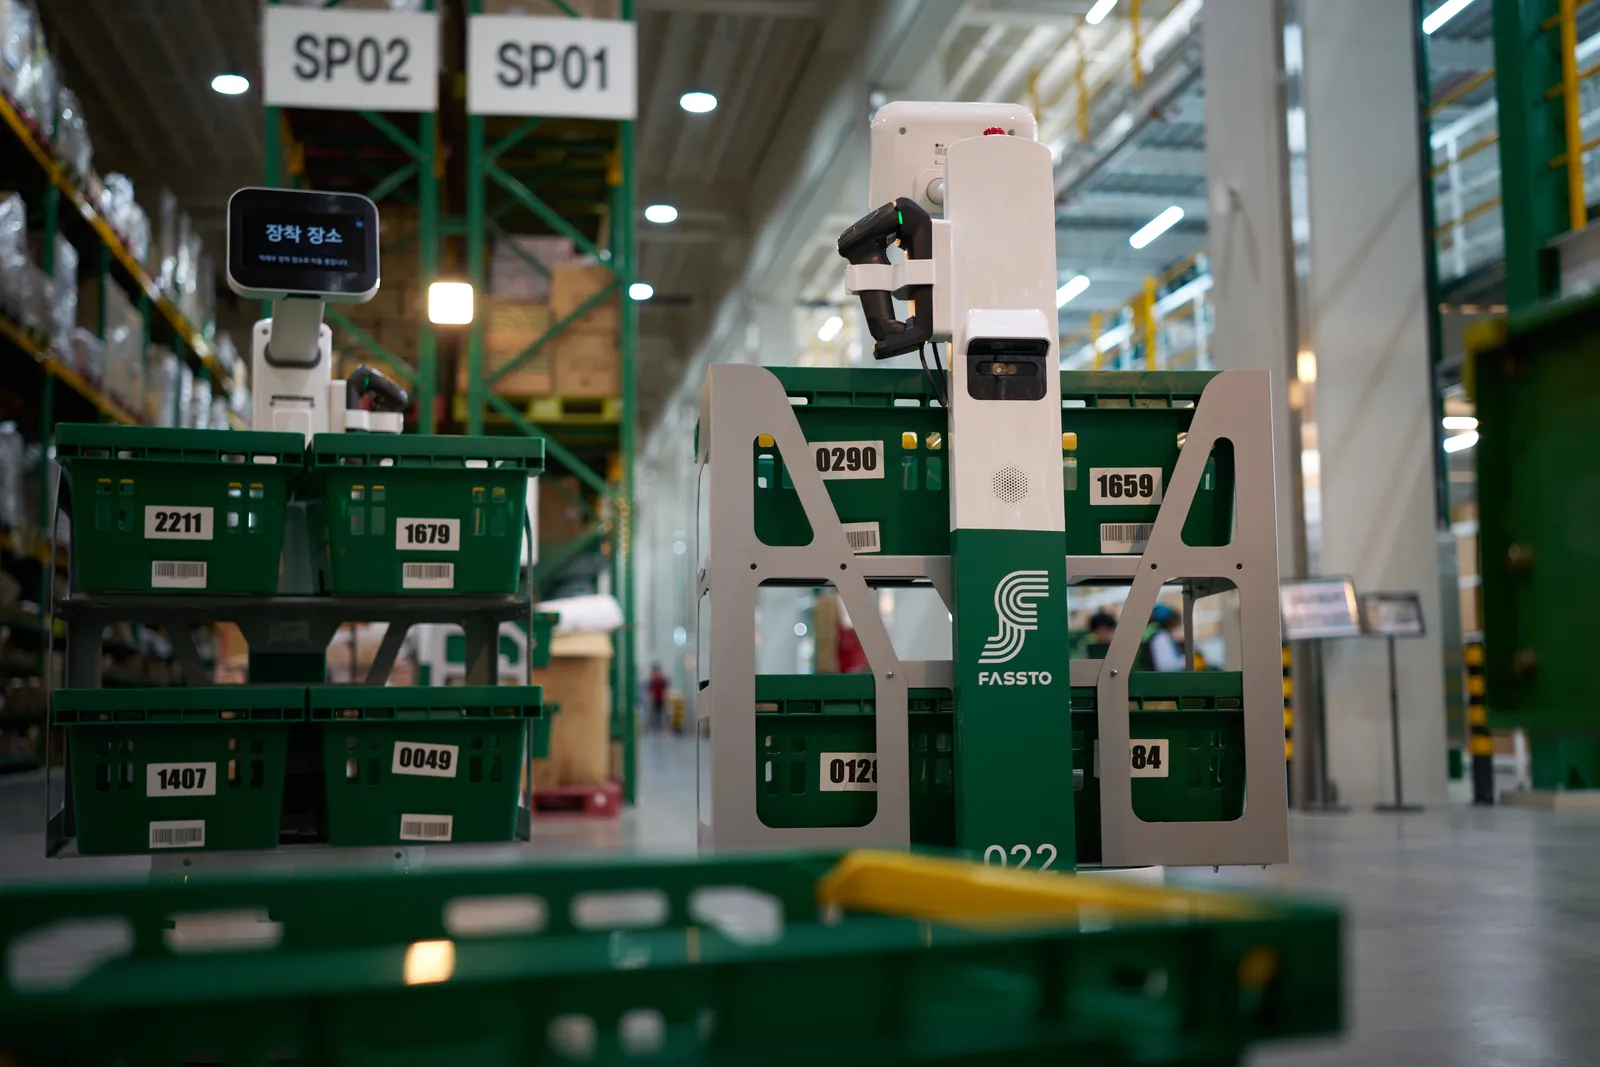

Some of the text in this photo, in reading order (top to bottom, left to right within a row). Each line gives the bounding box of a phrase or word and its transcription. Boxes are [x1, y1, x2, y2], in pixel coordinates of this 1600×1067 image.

[293, 32, 411, 84] SP02
[496, 41, 609, 91] SP01
[265, 223, 344, 245] 장착 장소
[816, 446, 877, 472] 0290
[1097, 473, 1154, 498] 1659
[155, 511, 202, 533] 2211
[404, 523, 451, 545] 1679
[978, 671, 1052, 686] FASSTO
[399, 747, 452, 770] 0049
[157, 768, 207, 790] 1407
[830, 758, 877, 783] 012
